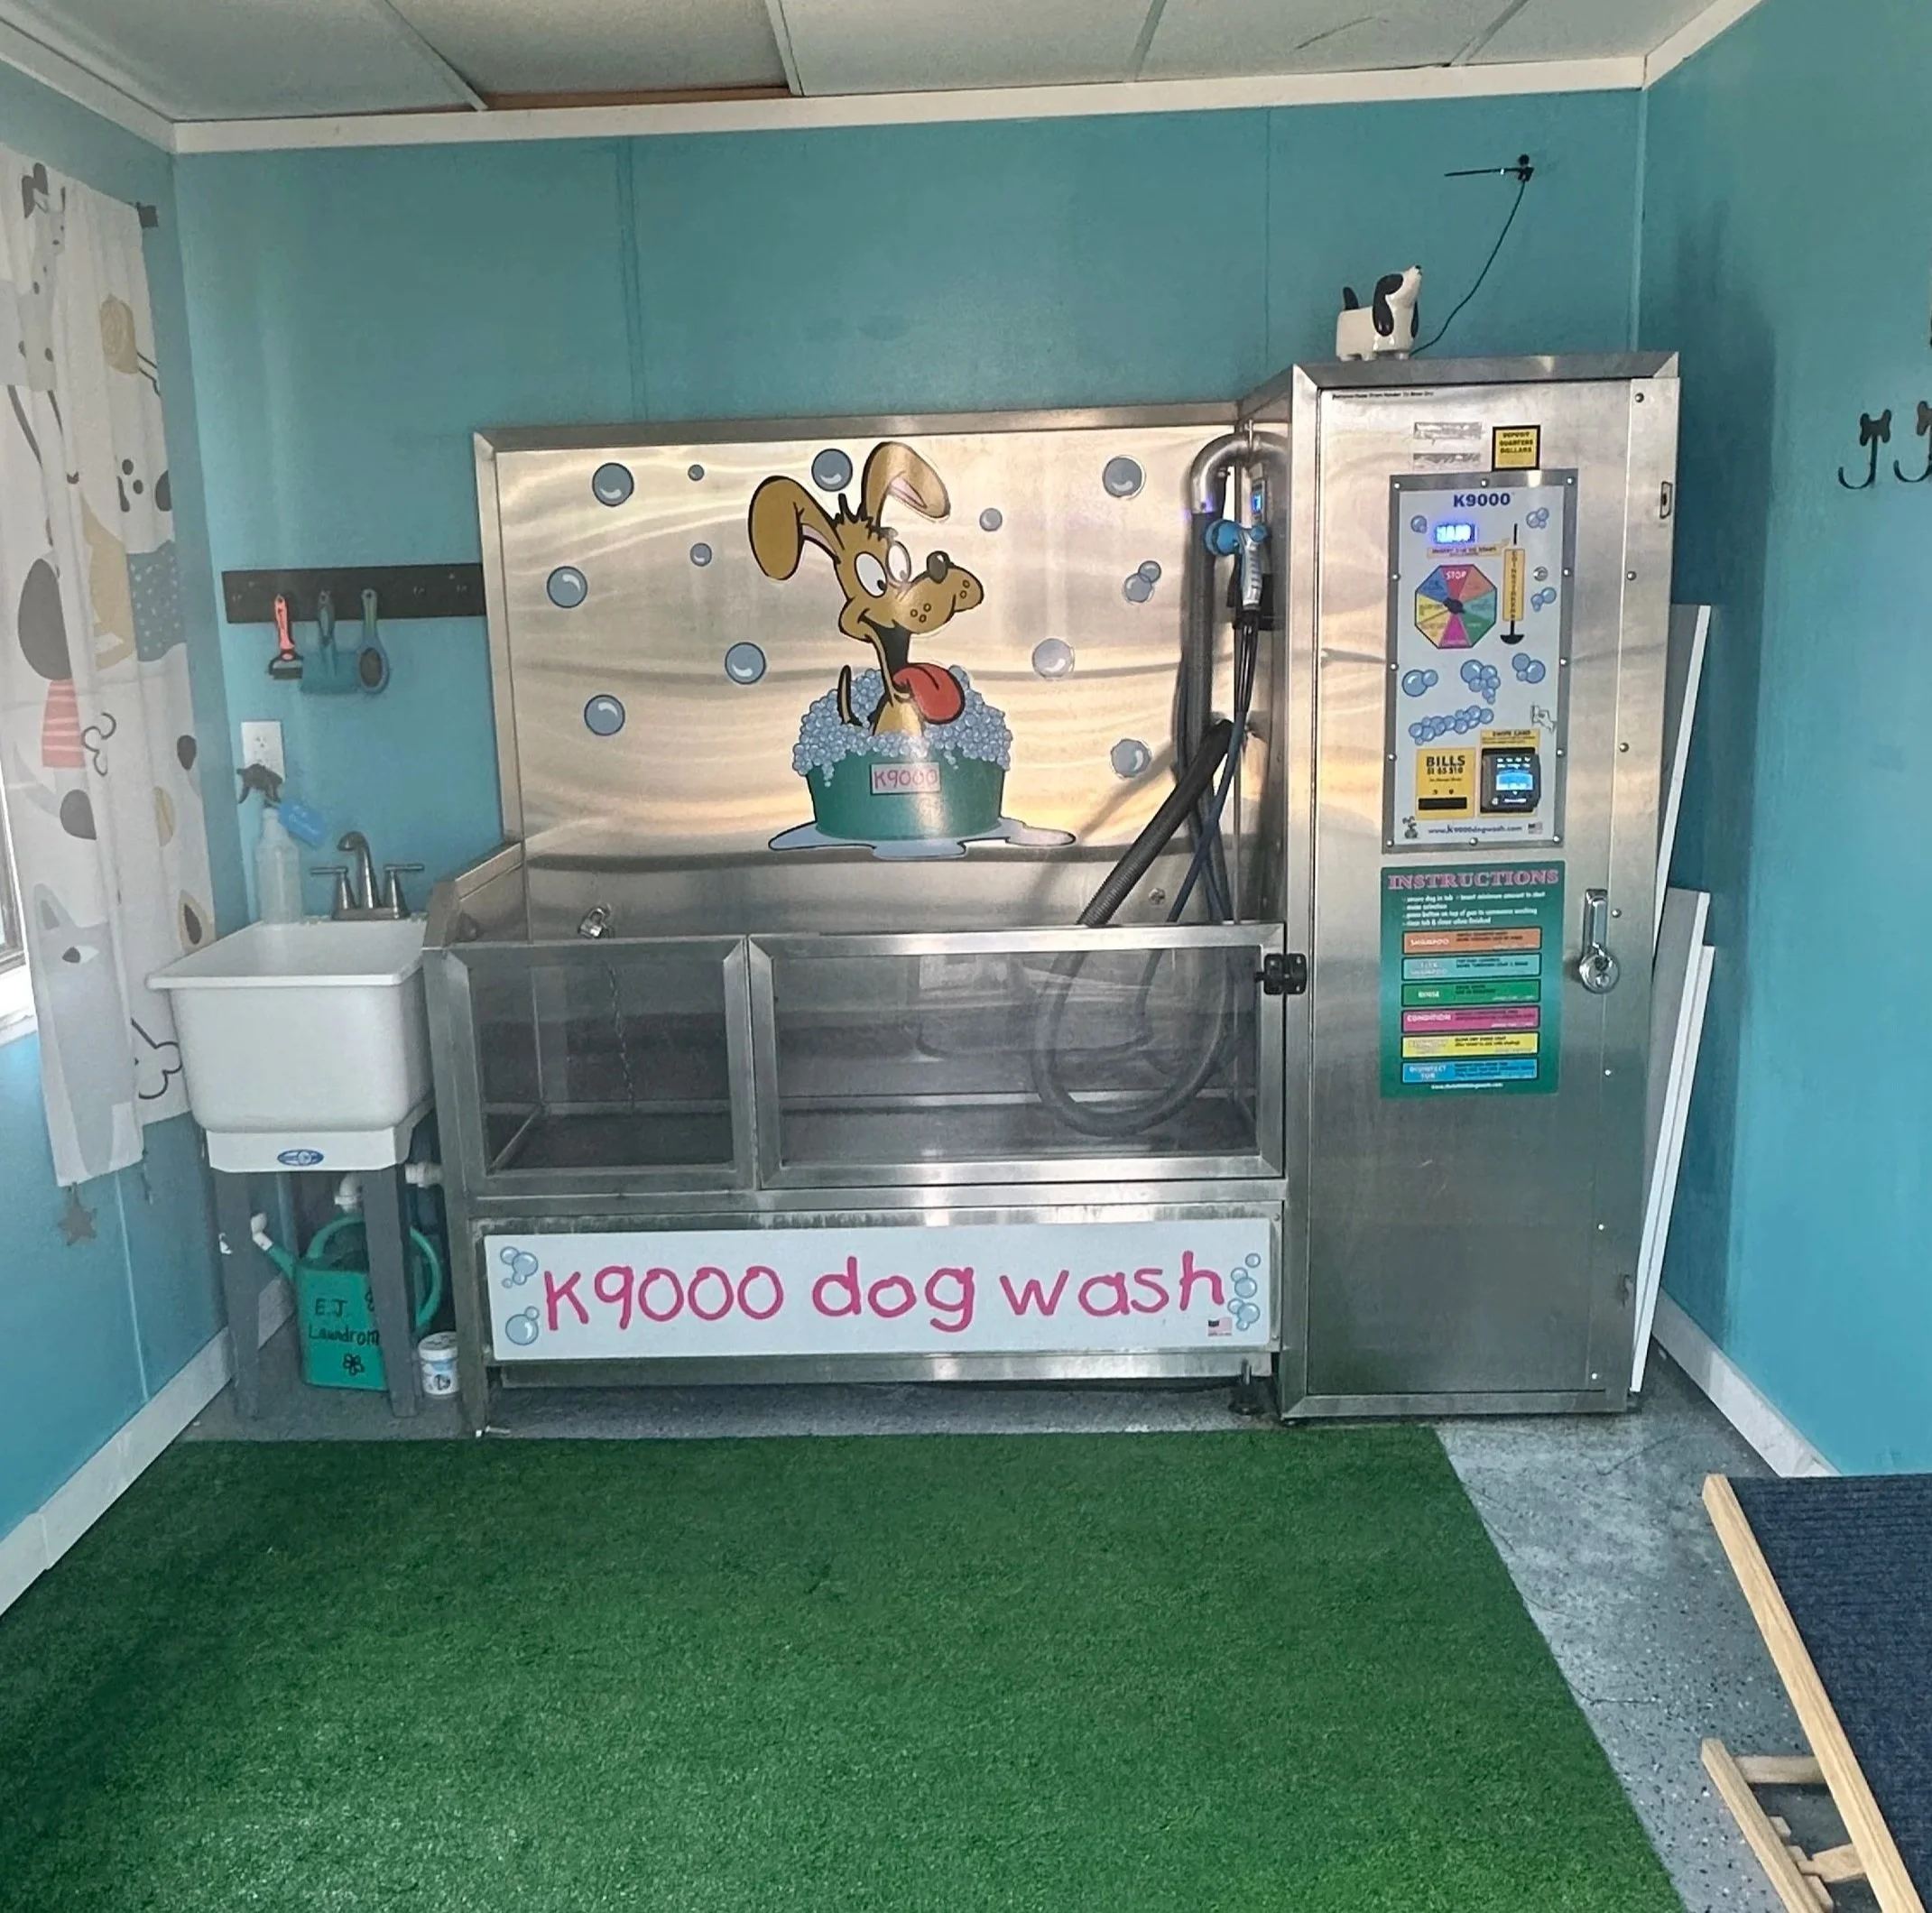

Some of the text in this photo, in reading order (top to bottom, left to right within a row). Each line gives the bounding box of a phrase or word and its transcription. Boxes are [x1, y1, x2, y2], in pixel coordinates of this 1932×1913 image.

[1453, 493, 1511, 507] K9000
[1446, 570, 1467, 580] STOP
[1426, 754, 1465, 767] BILLS
[874, 769, 938, 790] K9000
[1387, 869, 1559, 891] INSTRUCTIONS
[1410, 938, 1450, 947] SHAMPOO
[543, 1250, 1225, 1333] K9000 dog wash
